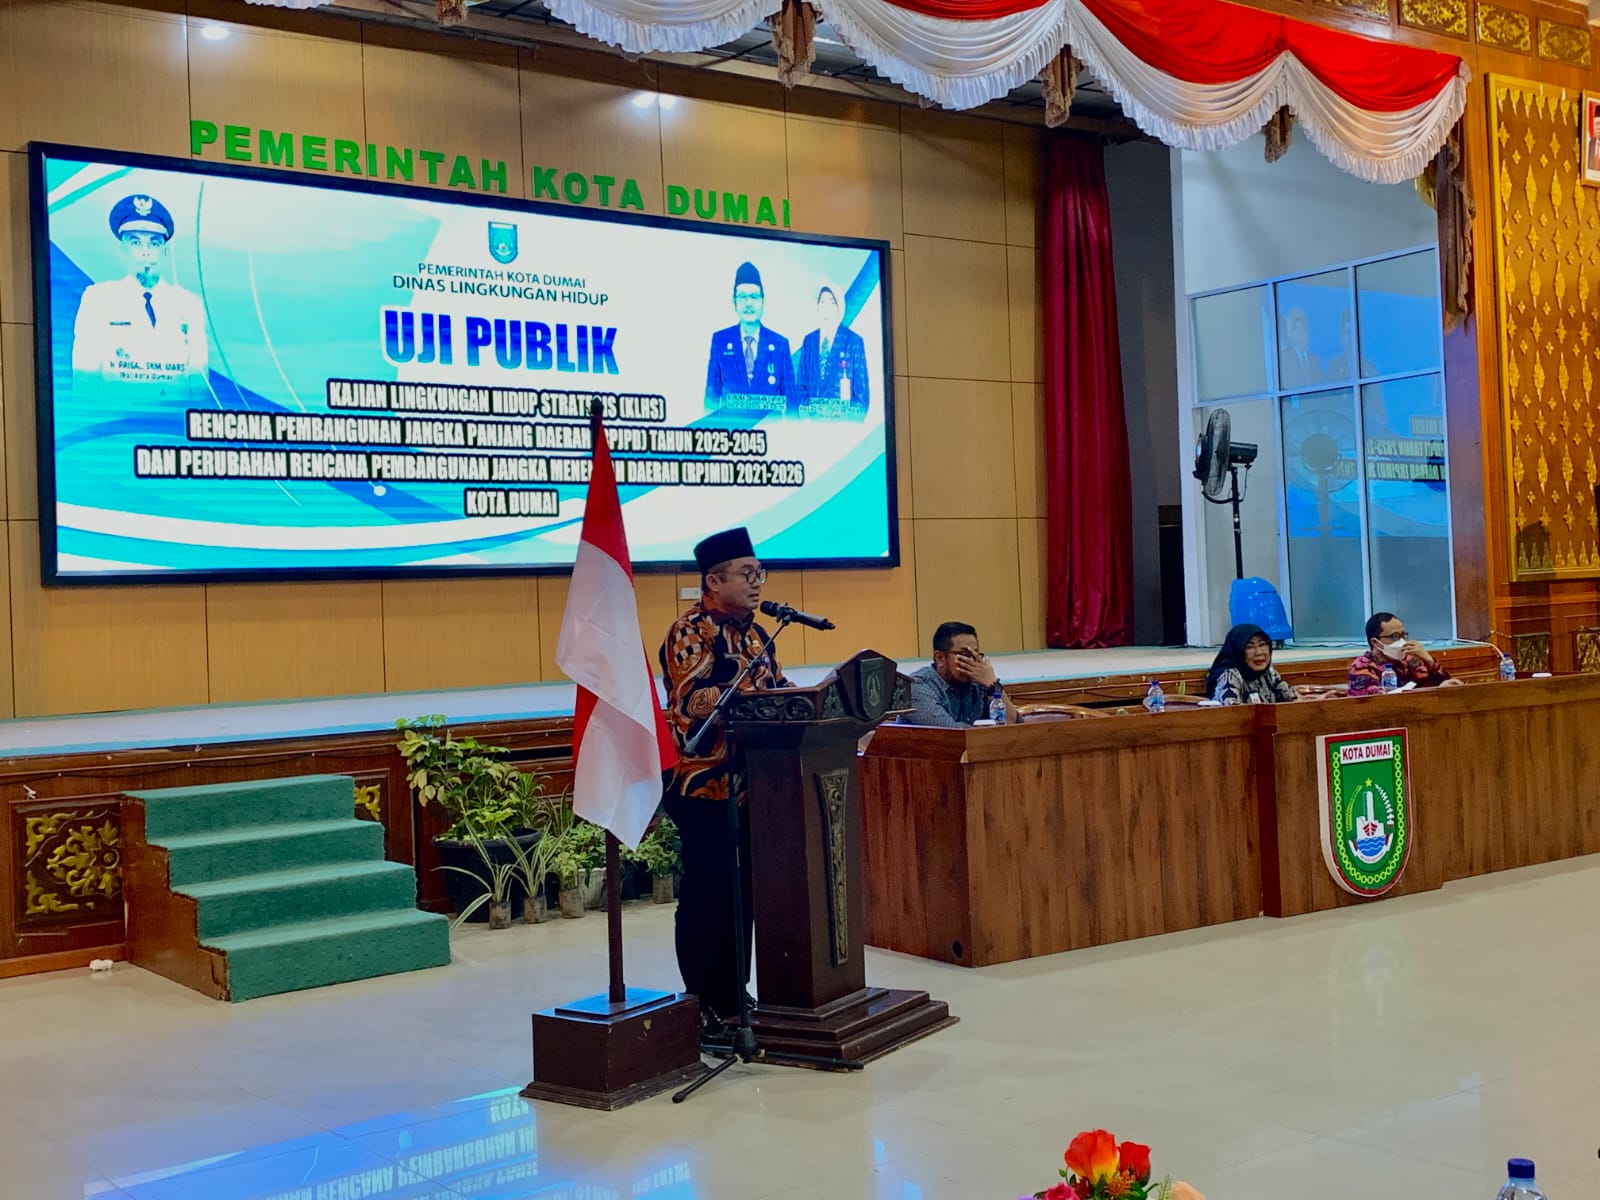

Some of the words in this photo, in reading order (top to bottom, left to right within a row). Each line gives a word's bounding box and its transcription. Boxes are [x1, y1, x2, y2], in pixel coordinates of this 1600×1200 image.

[190, 119, 508, 194] PEMERINTAH
[532, 165, 645, 211] KOTA
[666, 184, 791, 228] DUMAI
[392, 274, 446, 293] DINAS
[450, 280, 557, 302] LINGKUNGAN
[561, 290, 609, 306] HIDUP
[417, 262, 504, 281] PEMERINTAH
[507, 270, 541, 285] KOTA
[543, 274, 586, 289] DUMAI
[384, 309, 453, 365] UJI
[465, 315, 620, 375] PUBLIK
[329, 381, 388, 408] KAJIAN
[390, 384, 490, 413] LINGKUNGAN
[492, 389, 539, 416] HIDUP
[540, 392, 618, 420] STRATEIS
[619, 395, 665, 421] (KLHS)
[189, 412, 273, 440] RENCANA
[275, 416, 401, 444] PEMBANGUNAN
[404, 420, 465, 446] JANGKA
[466, 423, 534, 448] PANJANG
[535, 424, 592, 450] DAERAH
[602, 427, 648, 452] PJPD)
[649, 429, 693, 452] TAHUN
[694, 430, 766, 454] 2025-2045
[136, 448, 177, 476] DAN
[180, 449, 288, 477] PERUBAHAN
[289, 452, 369, 479] RENCANA
[370, 454, 490, 481] PEMBANGUNAN
[491, 457, 549, 482] JANGKA
[627, 460, 680, 485] DAERAH
[681, 461, 735, 485] (RPJMD)
[736, 462, 804, 485] 2021-2026
[466, 490, 507, 516] KOTA
[508, 490, 558, 516] DUMAI
[1342, 746, 1365, 761] KOTA
[1365, 743, 1391, 759] DUMAI
